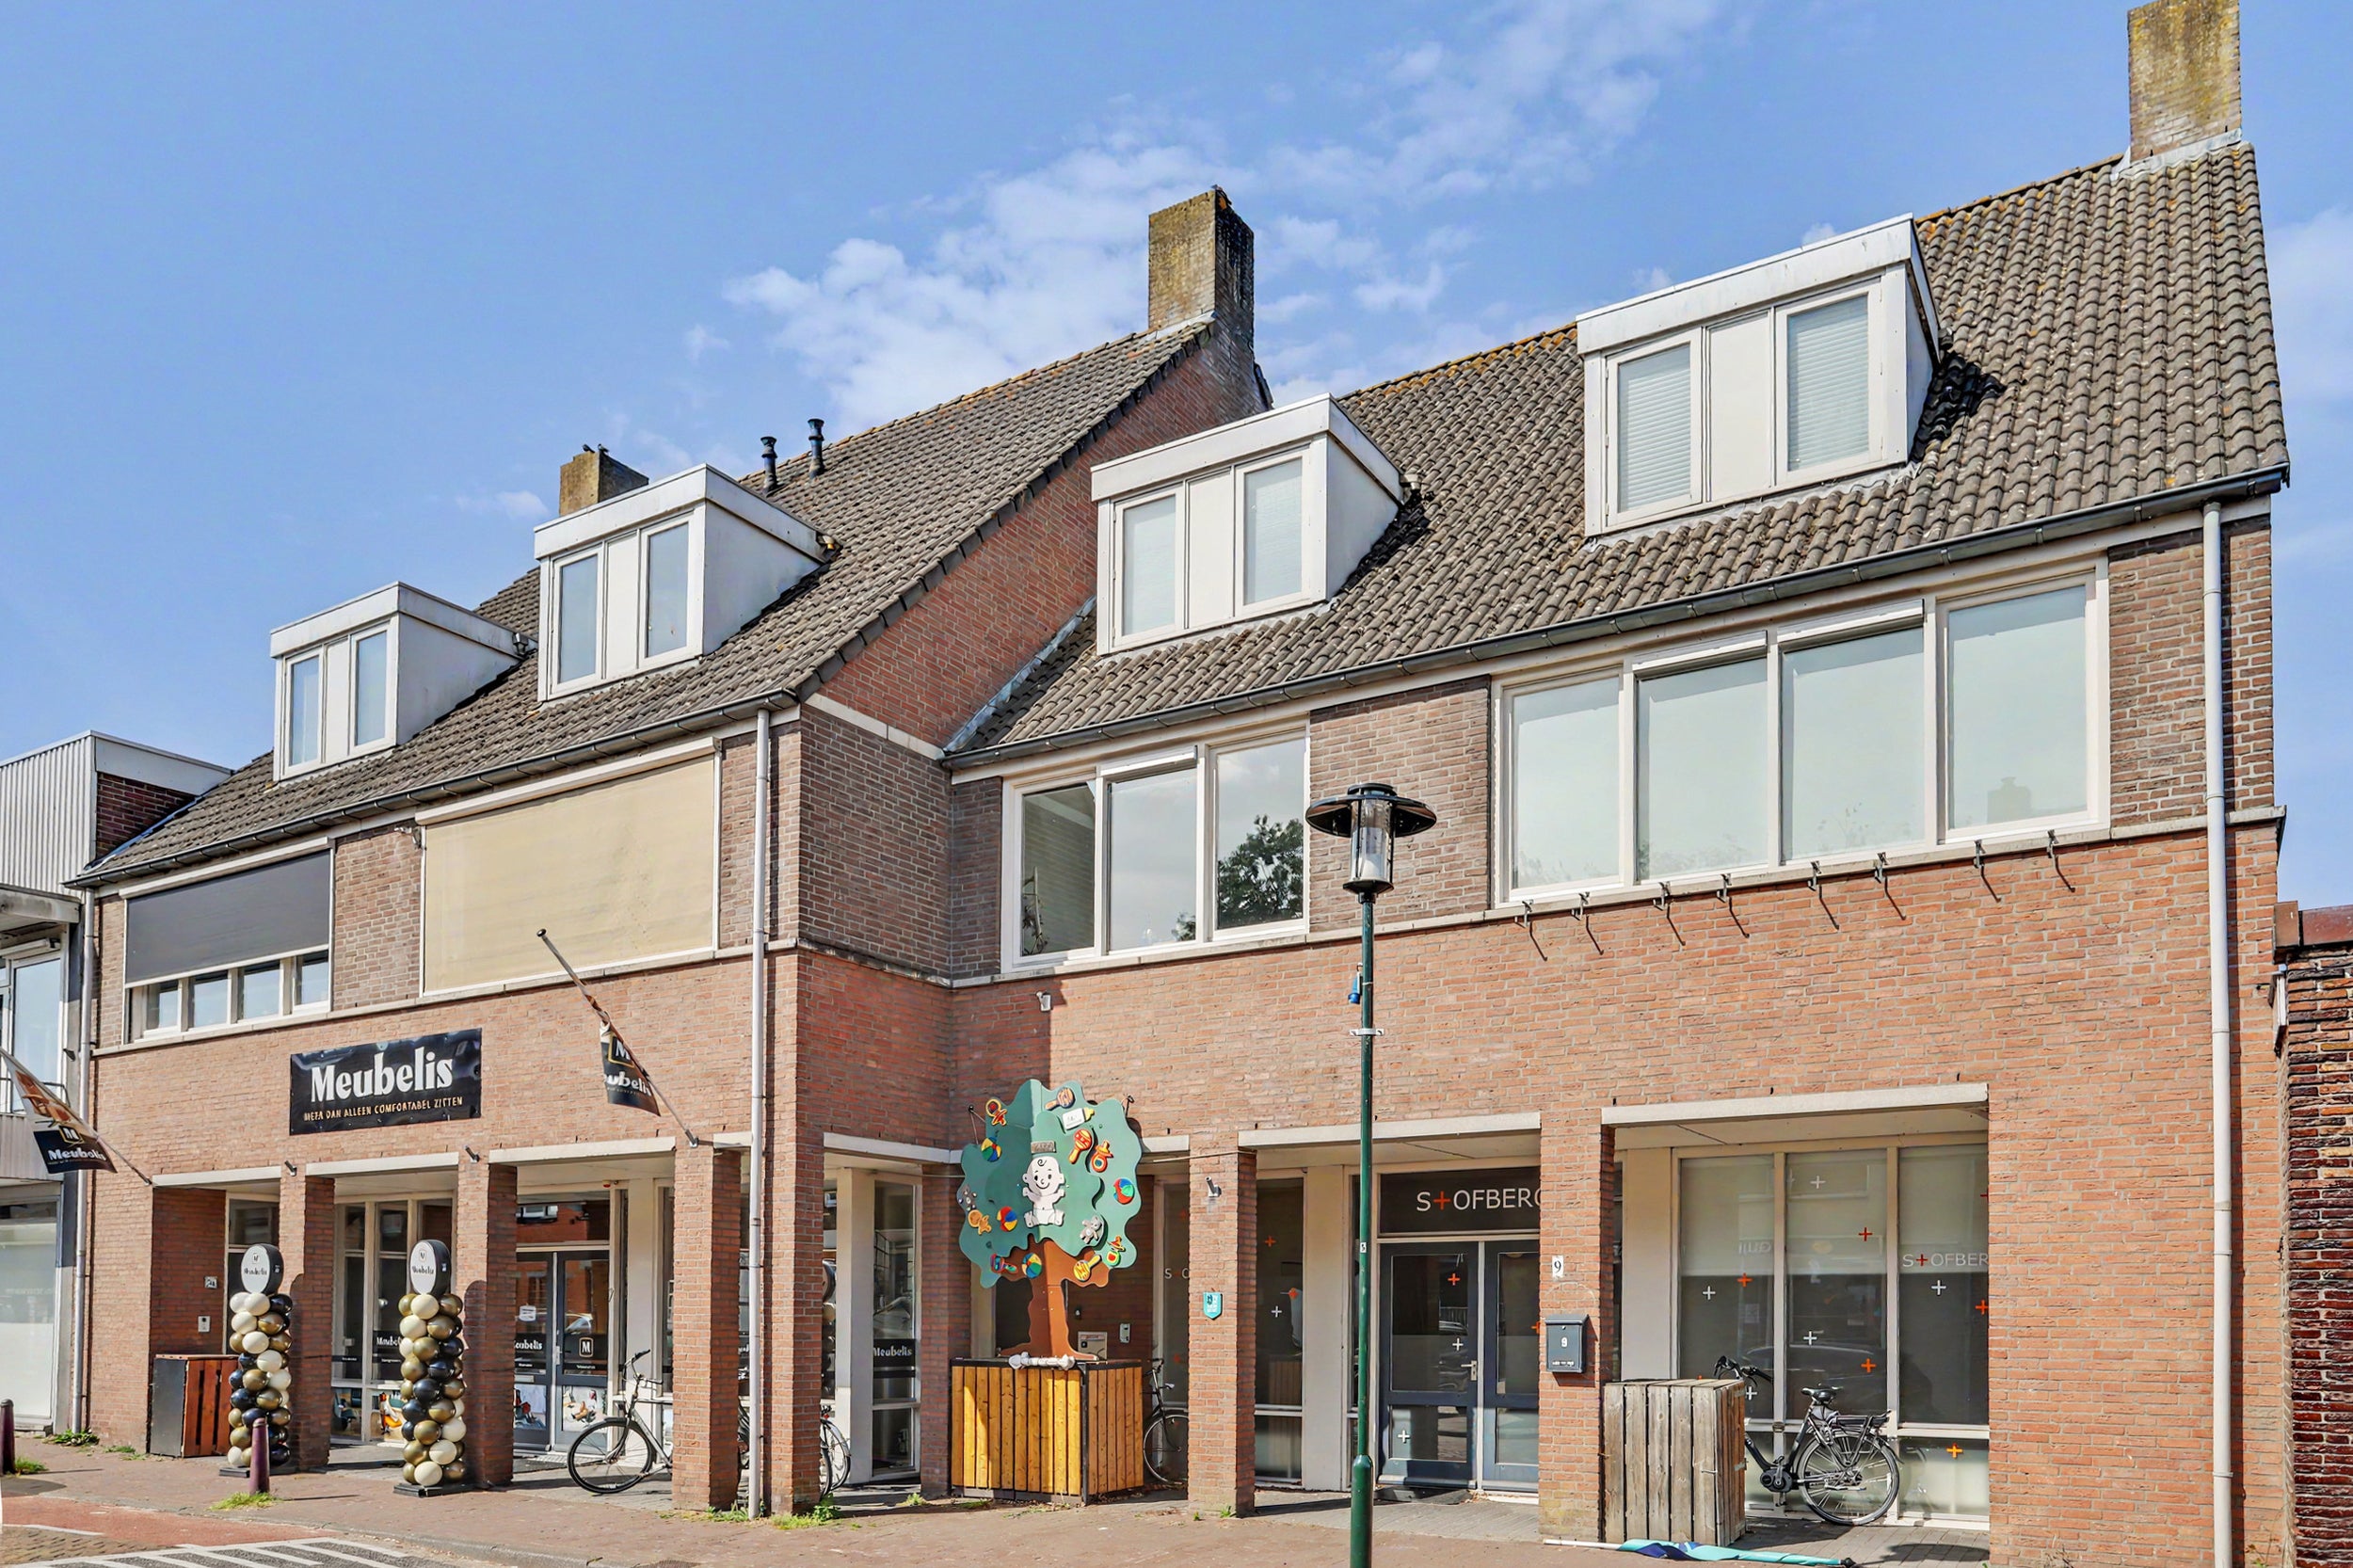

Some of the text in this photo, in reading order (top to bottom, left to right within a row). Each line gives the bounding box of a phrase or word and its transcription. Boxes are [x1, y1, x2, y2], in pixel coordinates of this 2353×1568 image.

[311, 1047, 453, 1103] Meubelis
[326, 1109, 342, 1119] DAN
[344, 1106, 372, 1117] ALLEEN
[374, 1099, 431, 1114] COMFORTABEL
[434, 1096, 463, 1109] ZITTEN
[1554, 1260, 1561, 1273] 9
[514, 1338, 543, 1350] eubelis
[582, 1341, 590, 1352] M
[1561, 1336, 1568, 1348] 9
